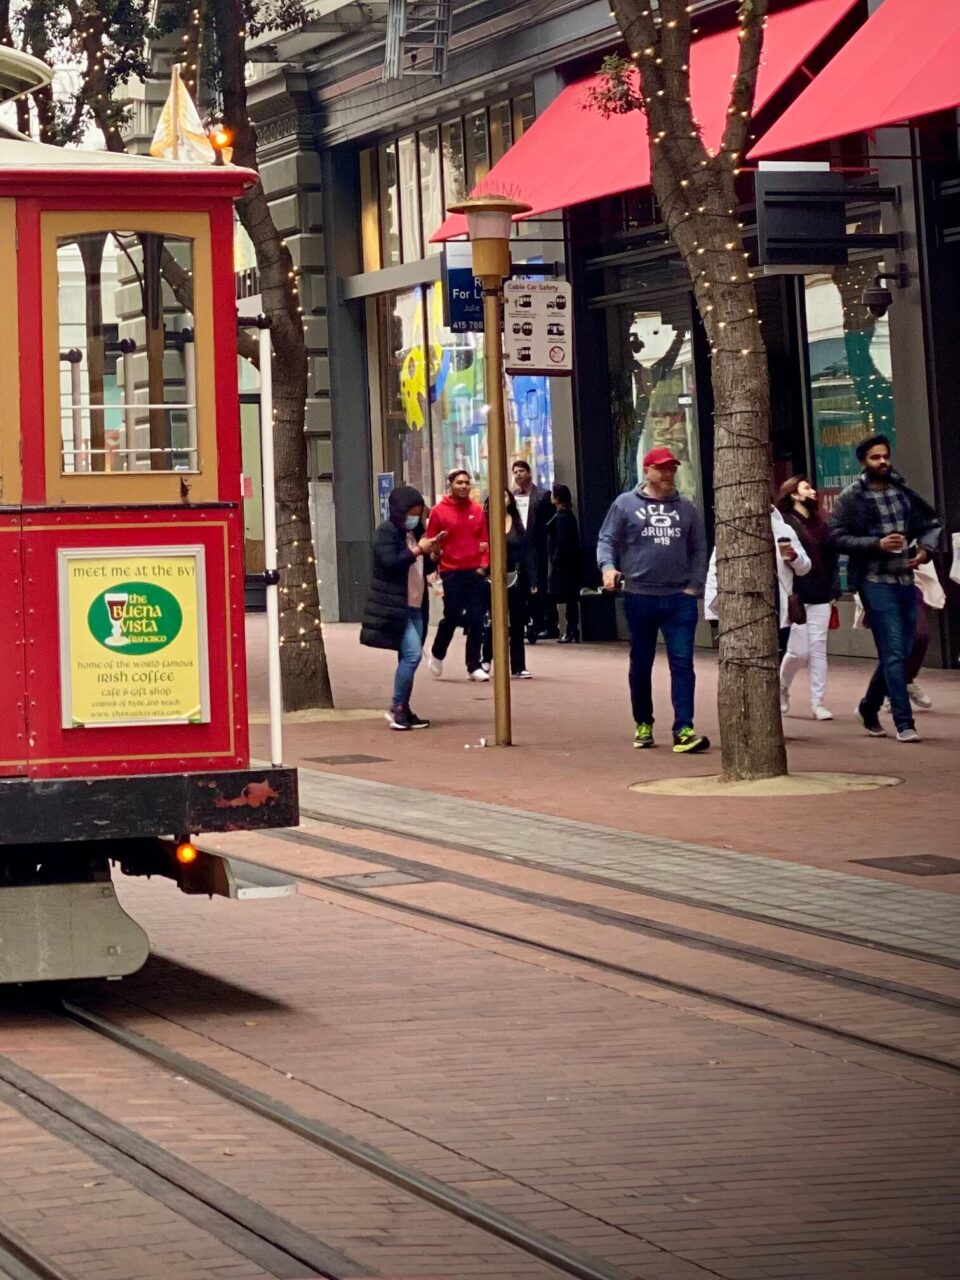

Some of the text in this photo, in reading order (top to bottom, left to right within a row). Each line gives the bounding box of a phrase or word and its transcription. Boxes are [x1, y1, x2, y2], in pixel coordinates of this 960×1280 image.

[539, 283, 559, 293] Safety
[453, 289, 470, 299] For
[463, 304, 480, 312] Julie
[453, 321, 467, 329] 415
[635, 504, 680, 520] UCLA
[641, 527, 681, 537] BRUINS
[74, 566, 105, 577] meet
[112, 567, 131, 577] me
[135, 566, 148, 576] at
[152, 565, 173, 576] the
[129, 593, 147, 604] the
